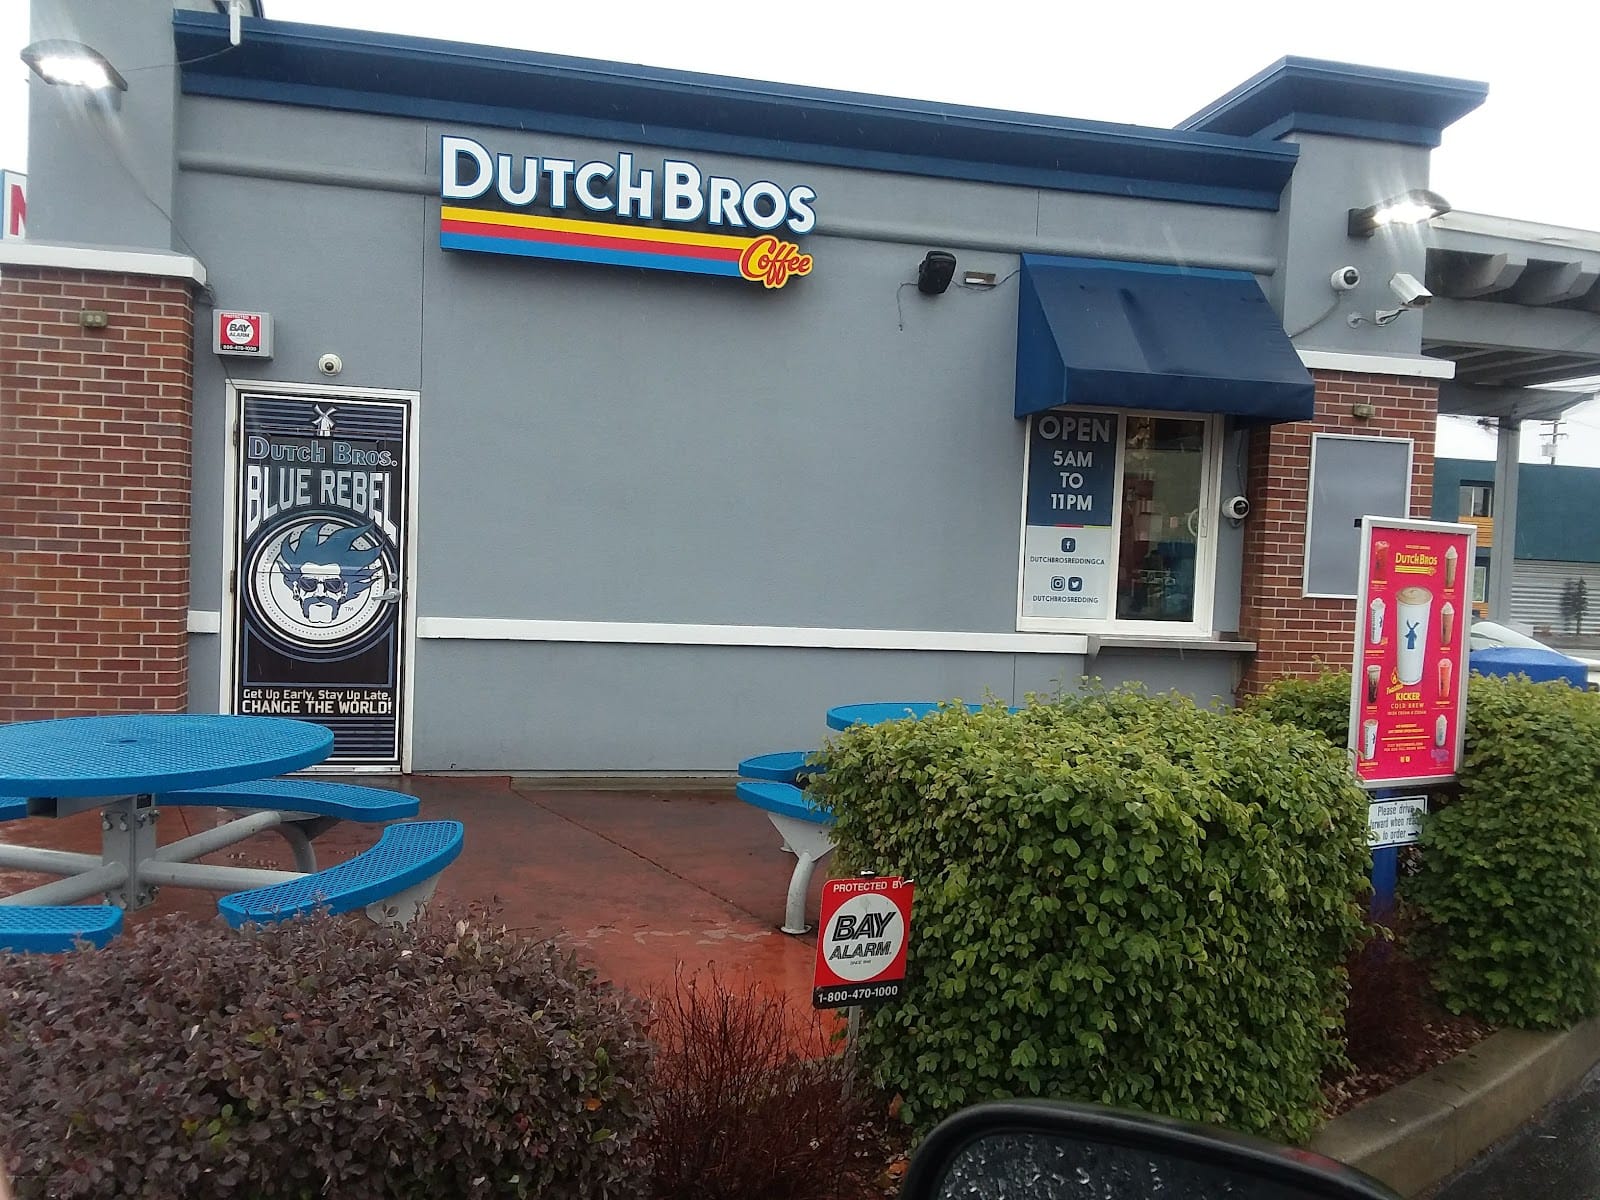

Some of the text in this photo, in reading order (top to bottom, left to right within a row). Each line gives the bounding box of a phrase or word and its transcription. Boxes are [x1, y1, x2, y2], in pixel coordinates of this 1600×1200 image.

[441, 135, 818, 235] DUTCH BROS
[740, 236, 812, 287] Coffee
[229, 323, 250, 333] BAY
[1038, 415, 1111, 443] OPEN
[248, 435, 398, 467] DUTCH BROS.
[1053, 450, 1093, 468] 5AM
[1059, 472, 1084, 489] TO
[246, 465, 398, 547] BLUE REBEL
[1050, 493, 1093, 511] 11PM
[1029, 556, 1105, 565] DUTCHBROSREDDINGCA
[1419, 554, 1438, 566] BROS
[1032, 595, 1099, 604] DUTCHBROSREDDING
[243, 689, 391, 702] Get Up Early, Stay Up Late,
[1395, 692, 1421, 701] KICKER
[242, 700, 392, 714] CHANGE THE WORLD!
[1377, 804, 1397, 816] Please
[1391, 816, 1405, 828] when
[1390, 828, 1406, 840] order
[833, 880, 904, 893] PROTECTED BY
[832, 911, 897, 942] BAY
[828, 941, 891, 961] ALARM
[818, 985, 898, 1003] 1-800-470-1000
